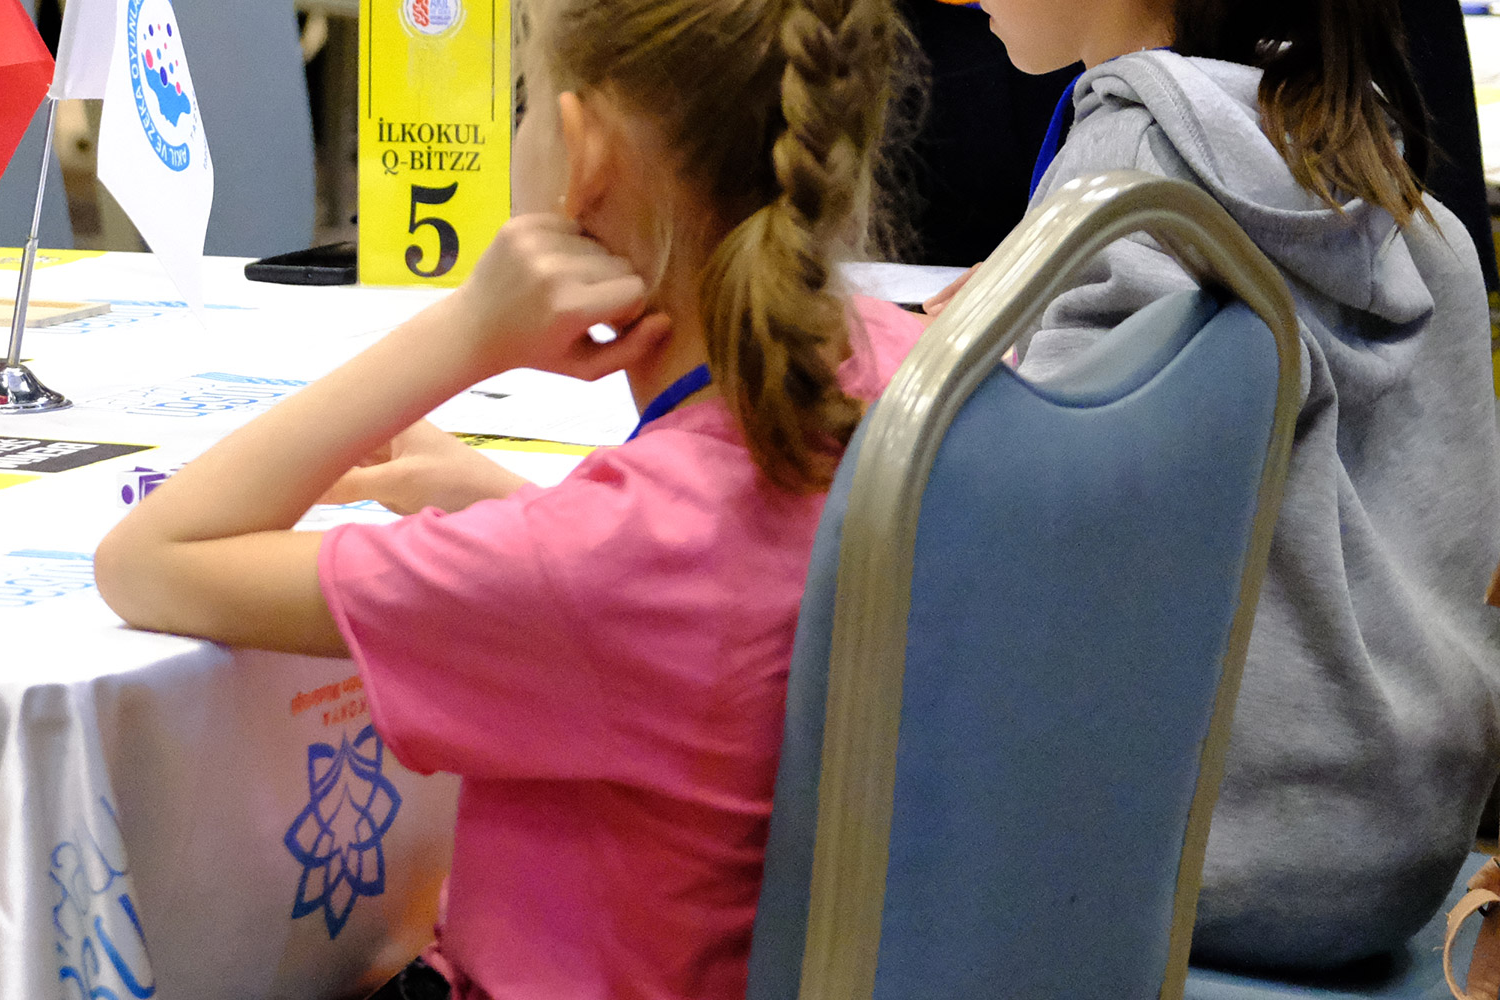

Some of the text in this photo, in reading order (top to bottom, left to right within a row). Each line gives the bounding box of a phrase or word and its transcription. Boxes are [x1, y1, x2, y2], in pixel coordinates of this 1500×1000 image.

[134, 88, 156, 138] ZEKA
[377, 117, 486, 145] İLKOKUL
[169, 147, 188, 168] AKIL
[382, 146, 481, 175] Q-BİTZZ
[404, 181, 460, 278] 5
